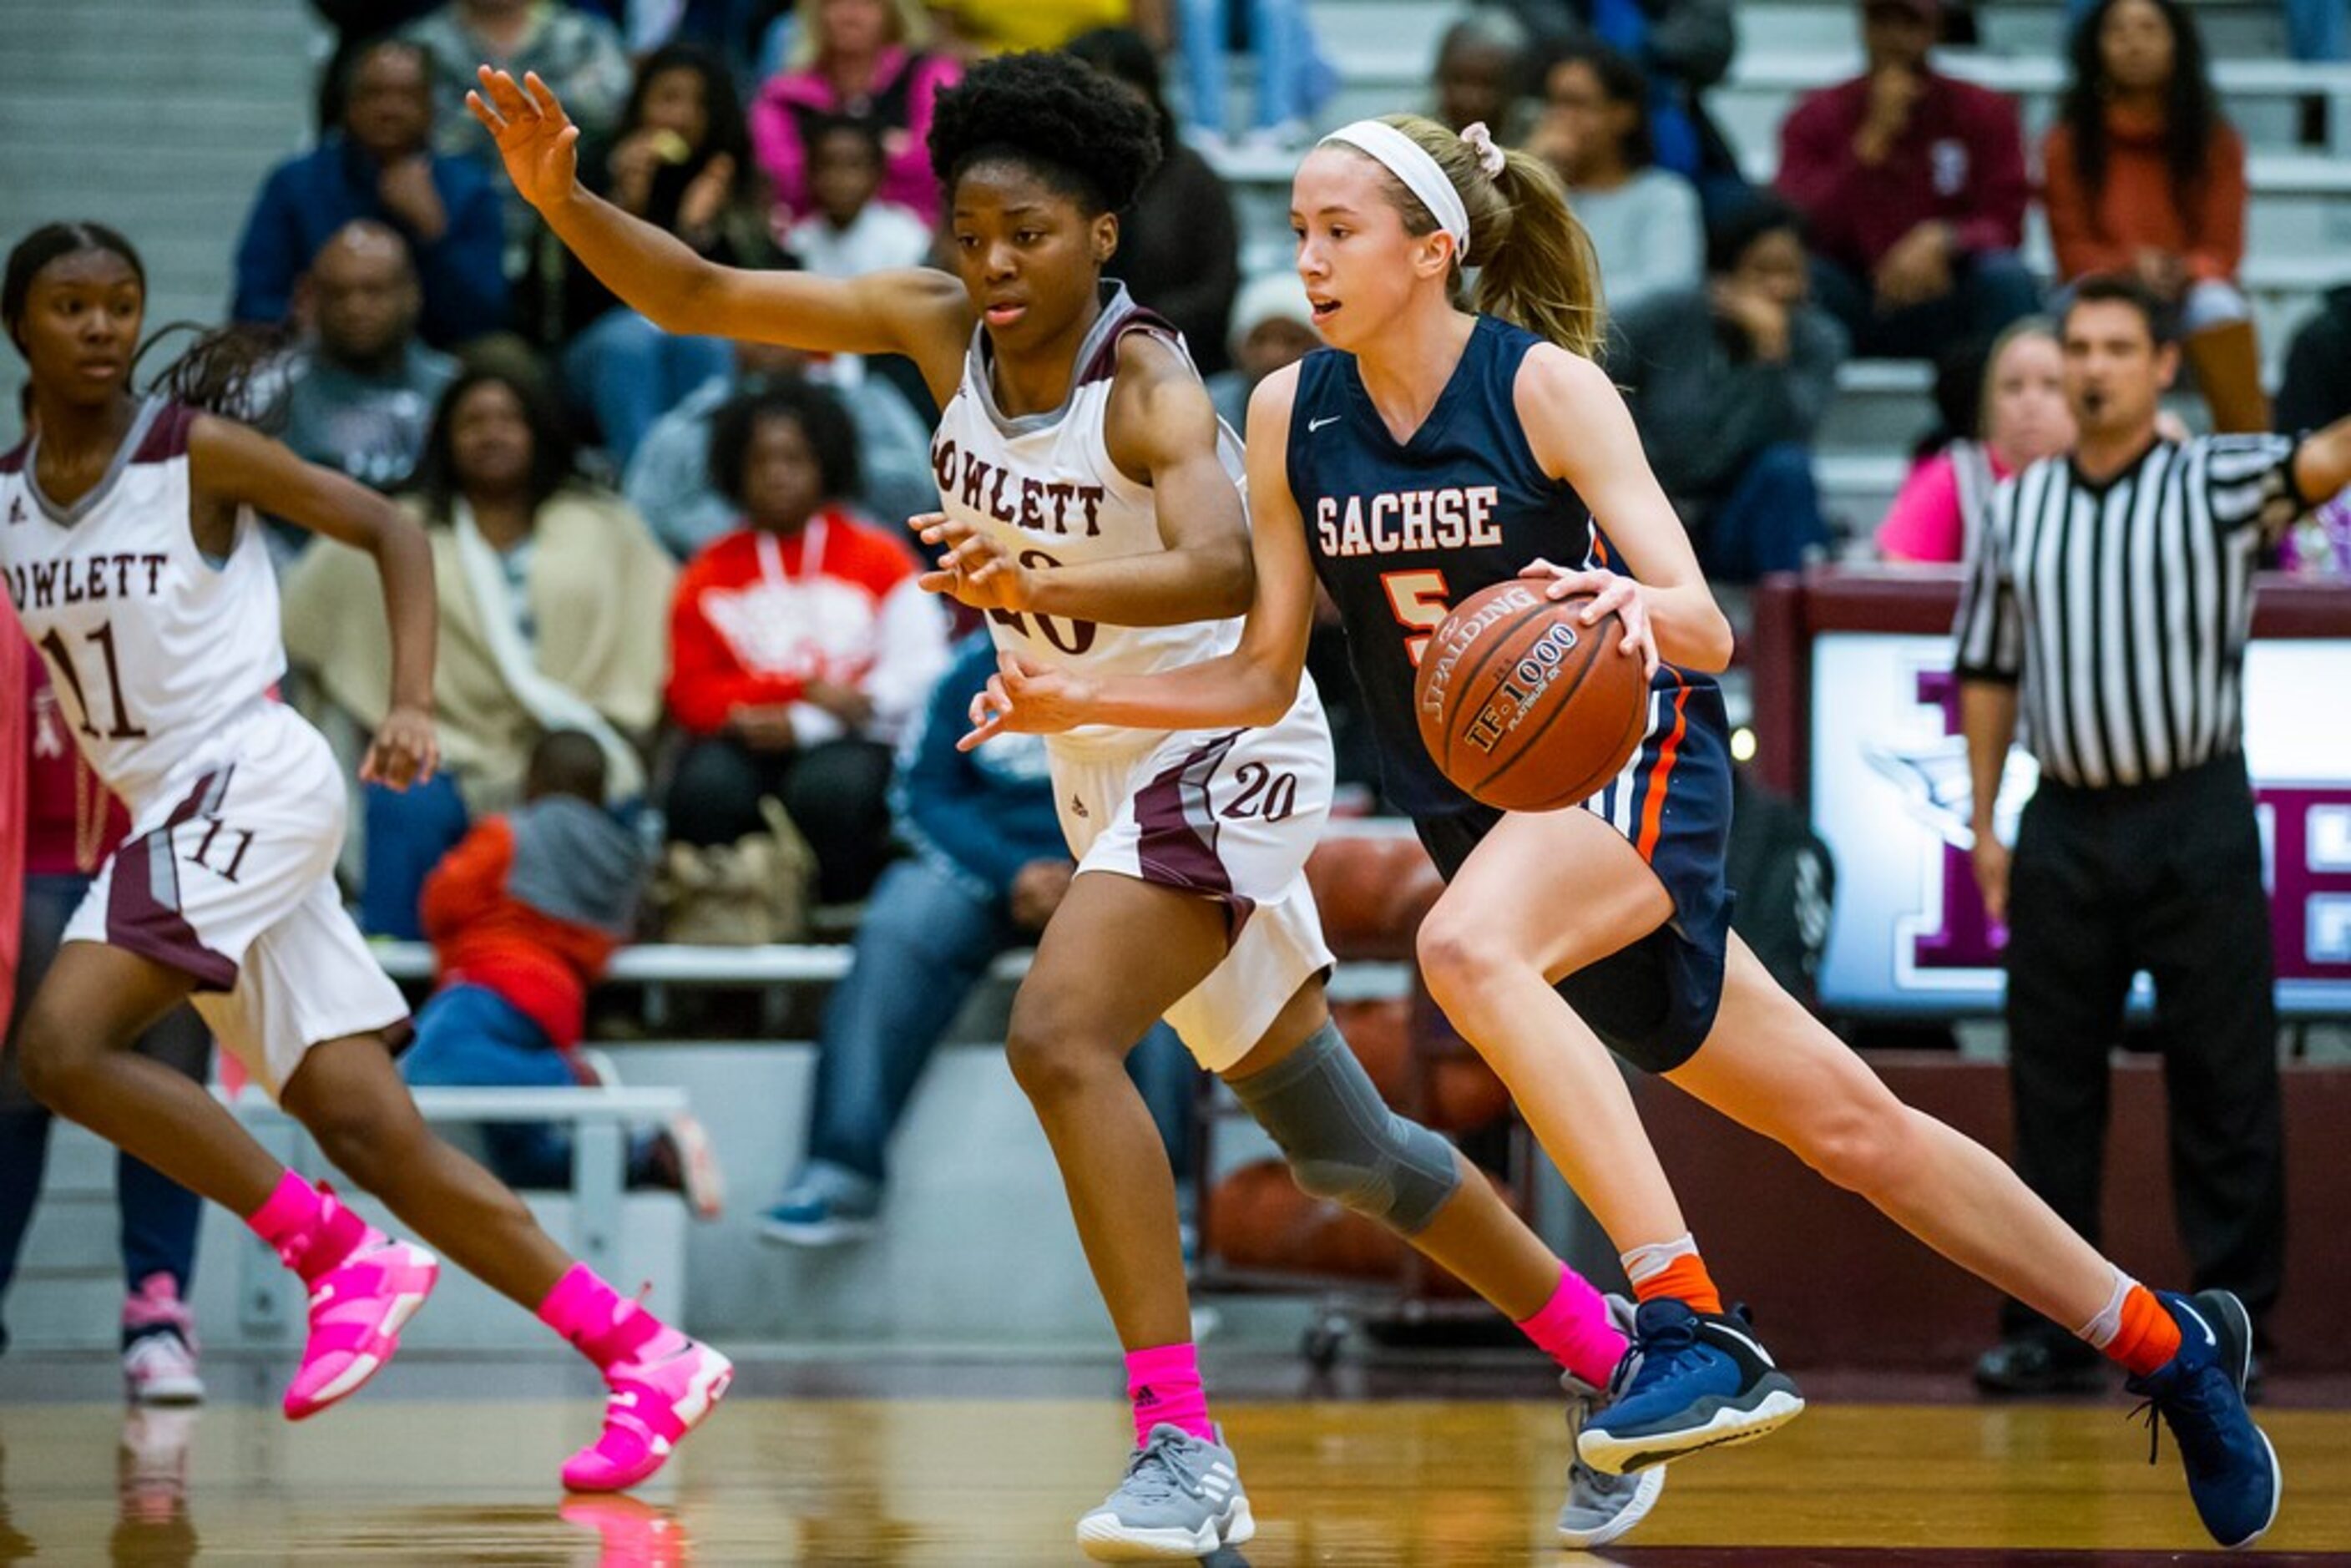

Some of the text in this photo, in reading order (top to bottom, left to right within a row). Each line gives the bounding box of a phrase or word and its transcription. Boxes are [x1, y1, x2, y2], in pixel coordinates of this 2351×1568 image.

[930, 432, 1105, 537] OWLETT
[1317, 486, 1502, 557] SACHSE
[0, 554, 169, 613] OWLETT
[1380, 569, 1451, 668] 5
[39, 618, 148, 741] 11
[1423, 586, 1539, 726] SPALDING
[1464, 622, 1579, 755] TF-1000
[1219, 761, 1297, 824] 20
[183, 813, 255, 884] 11
